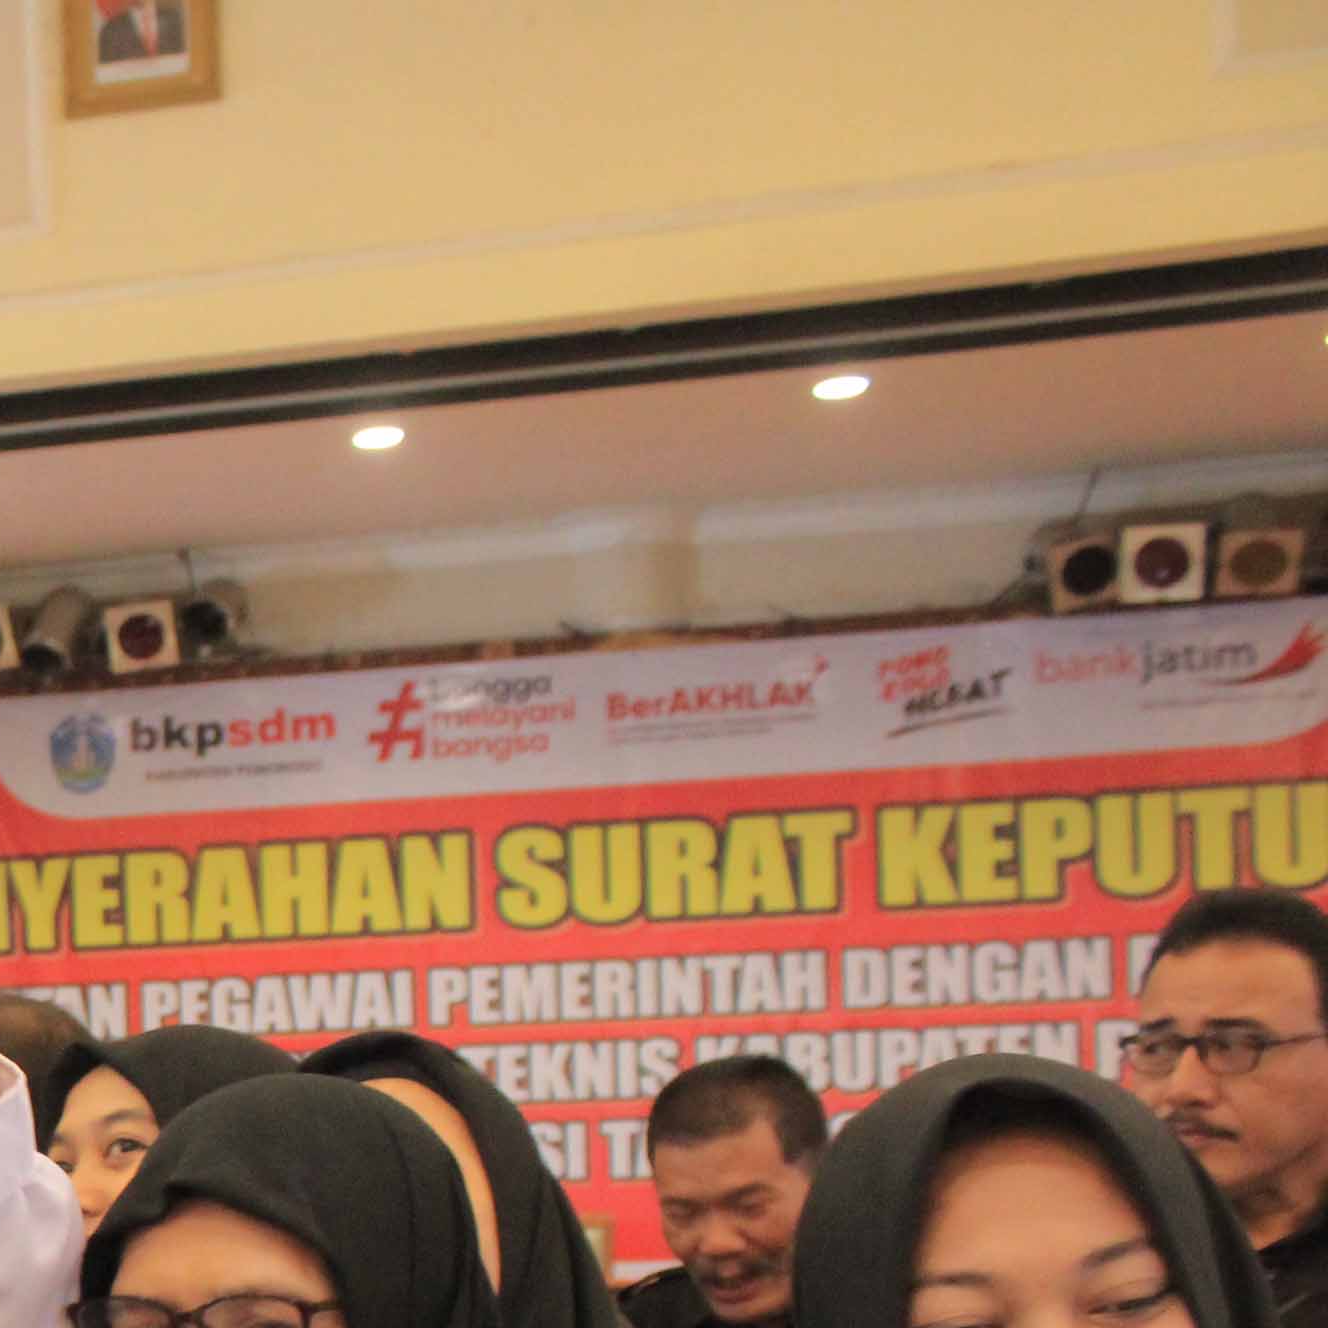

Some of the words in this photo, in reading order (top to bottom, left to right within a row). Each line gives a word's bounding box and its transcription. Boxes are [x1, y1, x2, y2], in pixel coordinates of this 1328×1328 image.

[427, 675, 552, 704] bngga
[606, 680, 814, 721] BerAKHLAK
[129, 707, 336, 757] bkpsdm
[431, 731, 550, 763] bangsa
[495, 806, 855, 930] SURAT
[141, 968, 414, 1033] PEGAWAI
[427, 949, 827, 1026] PEMERINTAH
[842, 936, 1112, 1010] DENGAN
[456, 1037, 680, 1102] TEKNIS
[694, 1021, 1079, 1092] BUPATEN
